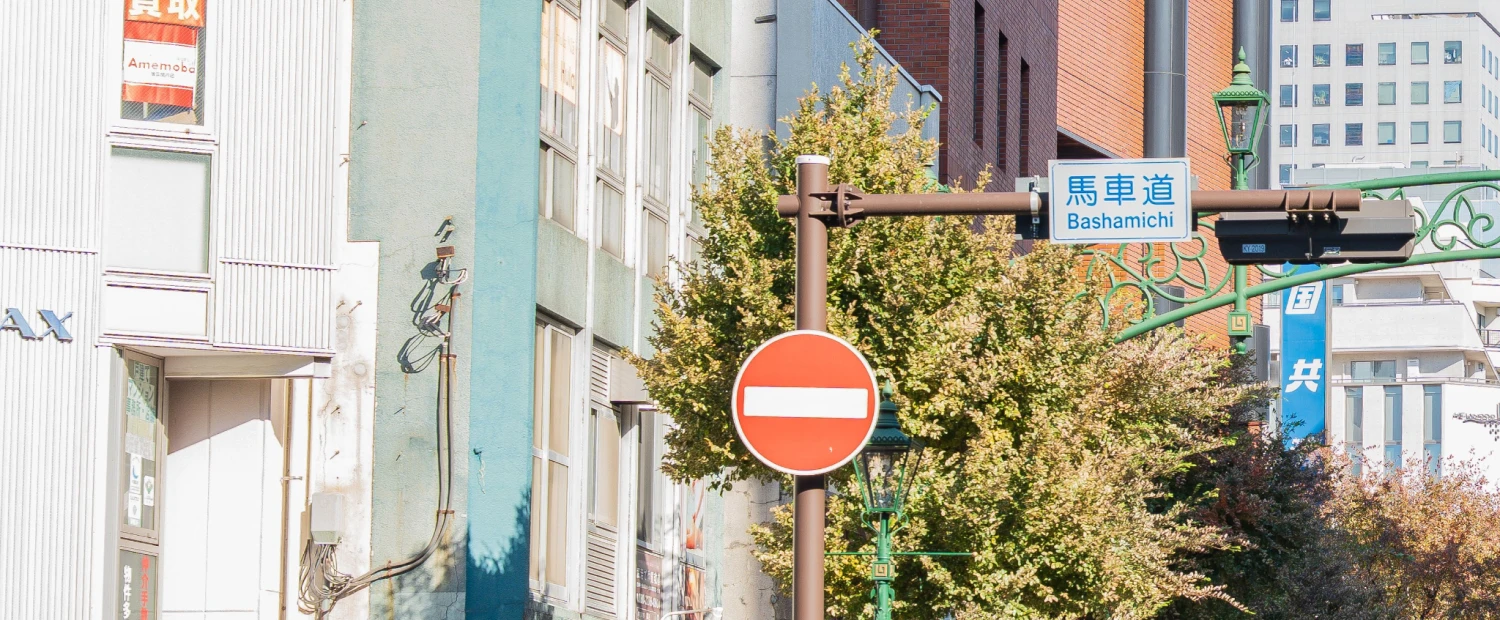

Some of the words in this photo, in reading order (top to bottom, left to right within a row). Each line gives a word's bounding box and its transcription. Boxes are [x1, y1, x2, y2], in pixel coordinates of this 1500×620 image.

[1066, 173, 1175, 207] 馬車道
[1067, 211, 1174, 230] Bashamichi
[0, 308, 74, 342] AX
